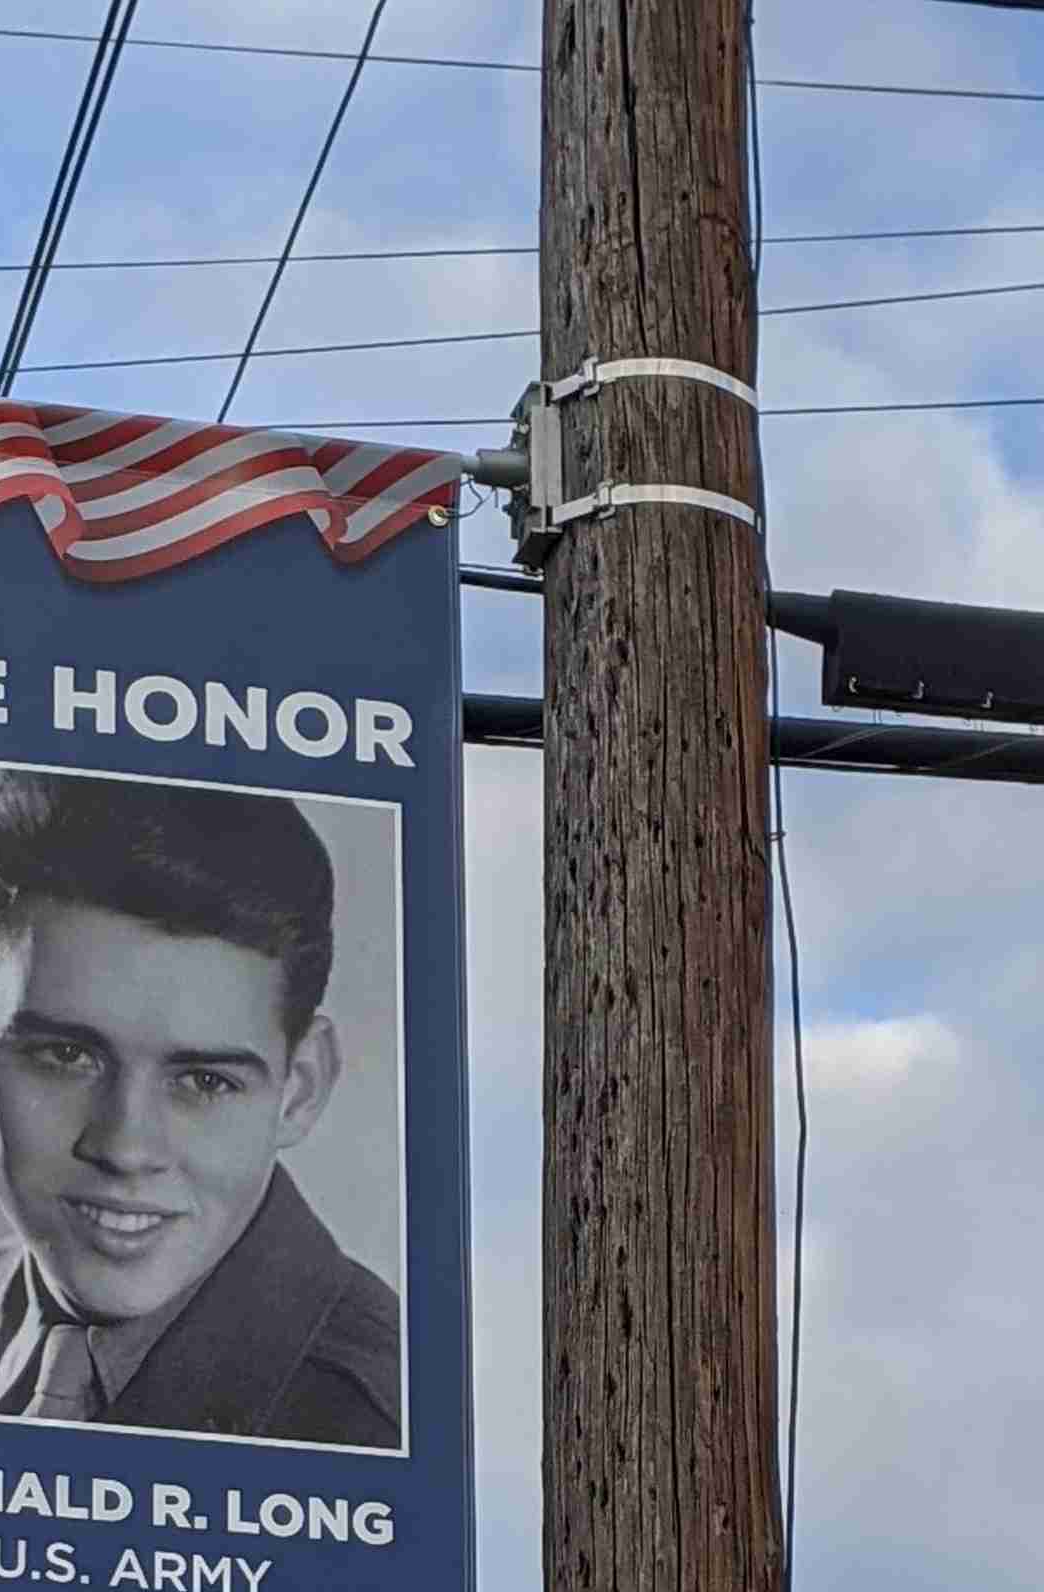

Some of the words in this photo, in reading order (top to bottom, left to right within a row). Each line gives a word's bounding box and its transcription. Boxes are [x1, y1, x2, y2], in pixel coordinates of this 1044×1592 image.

[53, 665, 417, 768] HONOR
[152, 1483, 209, 1531] R.
[226, 1489, 395, 1546] LONG
